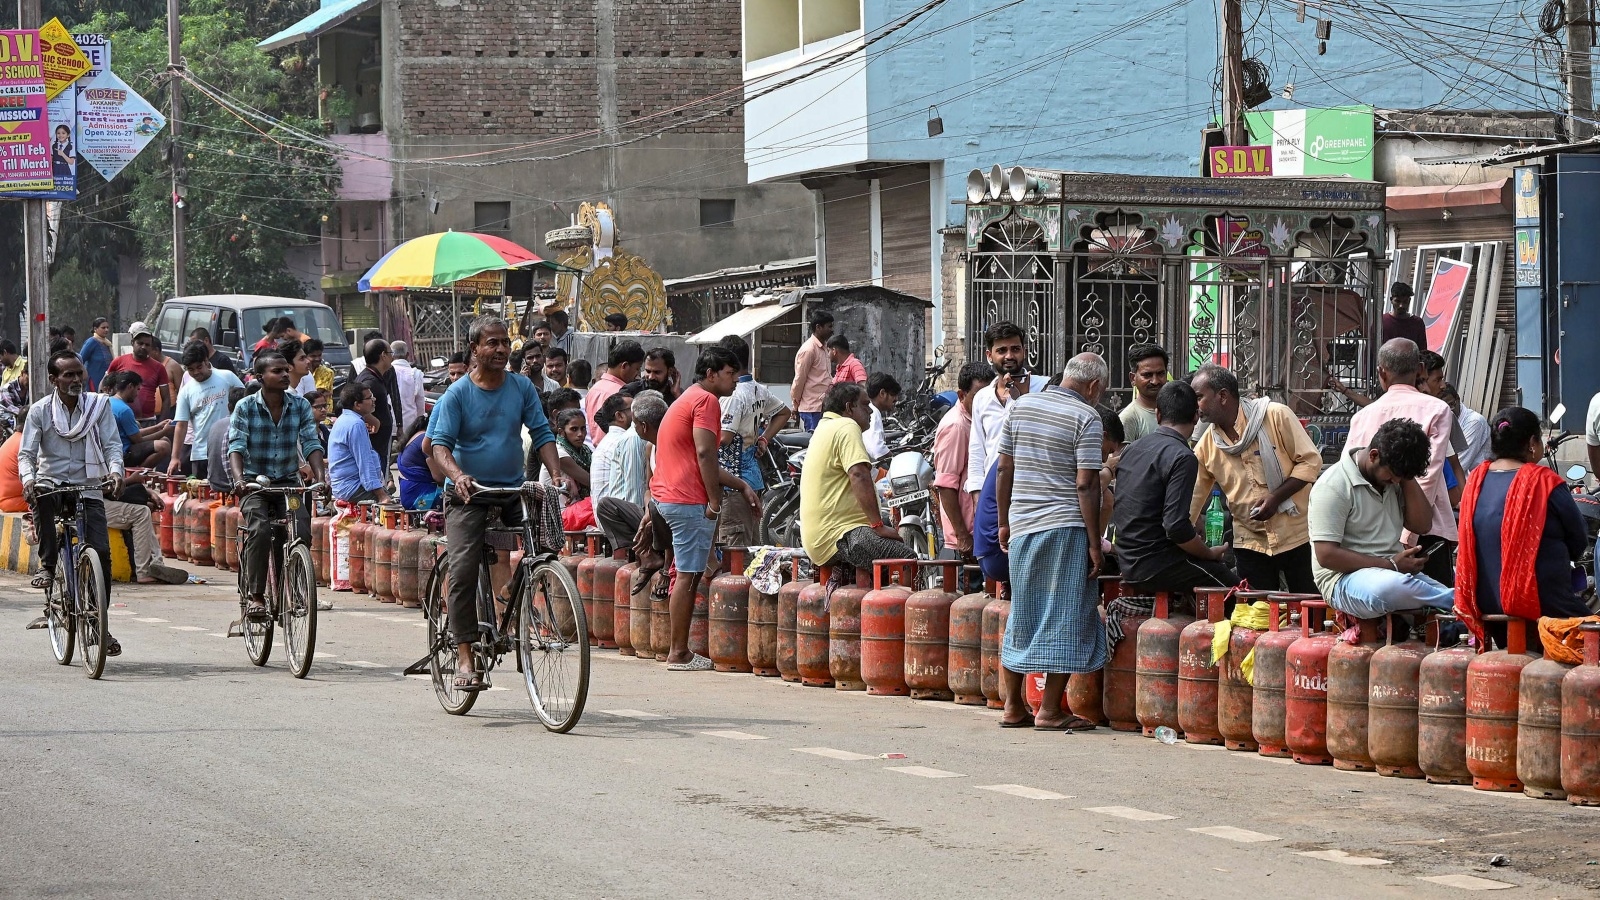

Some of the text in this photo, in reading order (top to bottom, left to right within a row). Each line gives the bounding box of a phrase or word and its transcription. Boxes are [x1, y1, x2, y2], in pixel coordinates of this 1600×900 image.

[56, 56, 85, 69] SCHOOL
[5, 65, 42, 78] SCHOOL
[85, 89, 127, 101] KIDZEE
[84, 128, 104, 137] Open
[10, 144, 25, 156] Till
[28, 143, 46, 156] Feb
[1324, 138, 1366, 148] GREENPANEL
[2, 157, 49, 170] Till March
[1214, 148, 1271, 174] S.D.V.
